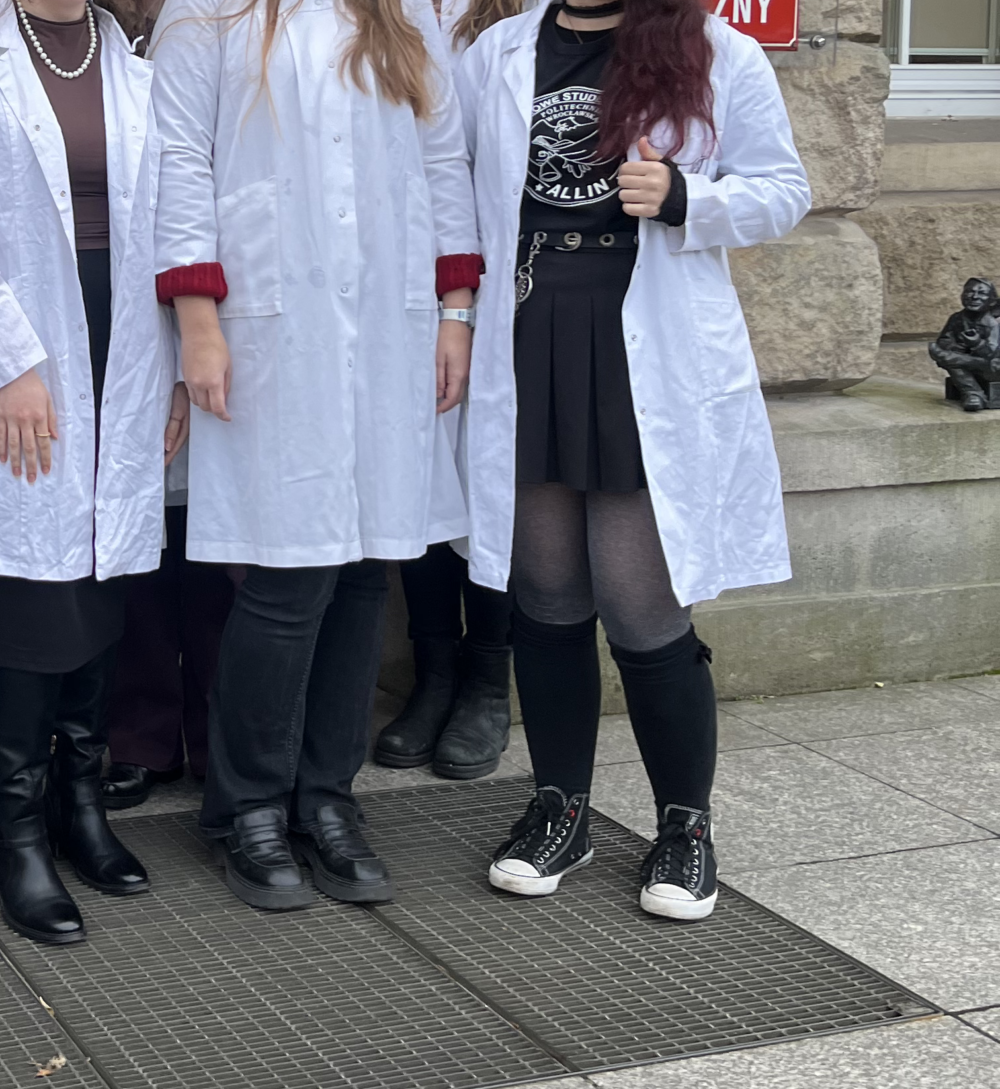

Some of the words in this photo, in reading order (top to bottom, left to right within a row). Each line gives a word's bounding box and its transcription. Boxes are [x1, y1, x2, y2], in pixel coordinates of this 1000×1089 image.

[533, 95, 560, 112] OWE
[562, 92, 598, 102] STUD
[545, 178, 610, 200] ALLIN
